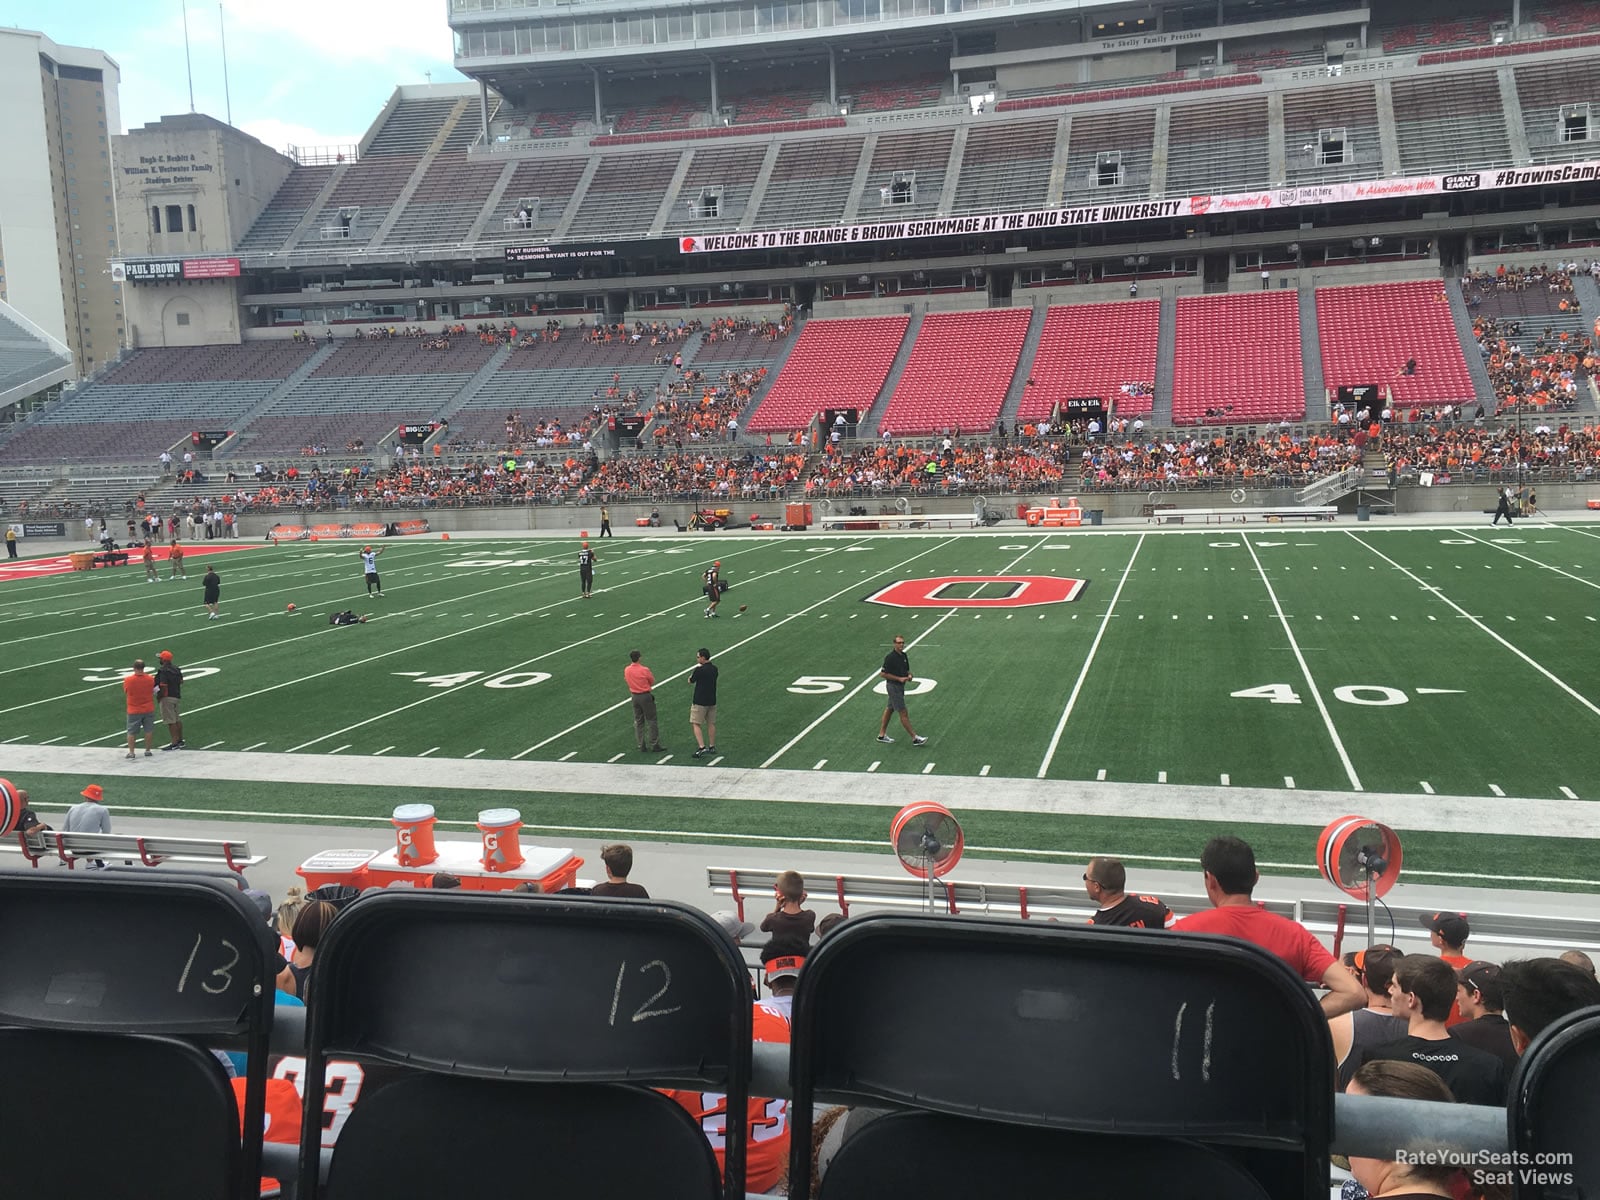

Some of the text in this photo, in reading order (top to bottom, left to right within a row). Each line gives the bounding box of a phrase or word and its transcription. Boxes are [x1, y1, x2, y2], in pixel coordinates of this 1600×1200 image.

[1143, 36, 1168, 45] Family
[191, 163, 213, 172] Family
[1416, 180, 1436, 191] With
[1446, 174, 1477, 184] GIANT
[1446, 181, 1476, 190] EAGLE
[1220, 195, 1261, 208] Presented
[1261, 194, 1272, 209] By
[704, 236, 758, 251] WELCOME
[762, 234, 776, 247] TO
[779, 232, 799, 245] THE
[803, 229, 848, 244] ORANGE
[851, 228, 859, 241] &
[862, 223, 905, 240] BROWN
[907, 218, 980, 236] SCRIMMAGE
[983, 216, 998, 231] AT
[1002, 214, 1024, 230] THE
[1027, 212, 1057, 227] OHIO
[1060, 207, 1100, 225] STATE
[1102, 200, 1181, 221] UNIVERSITY
[126, 264, 148, 275] PAUL
[150, 262, 180, 274] BROWN
[398, 829, 412, 845] G
[484, 833, 498, 850] G
[177, 933, 239, 994] 13
[609, 959, 682, 1027] 12
[1171, 1000, 1216, 1082] 11
